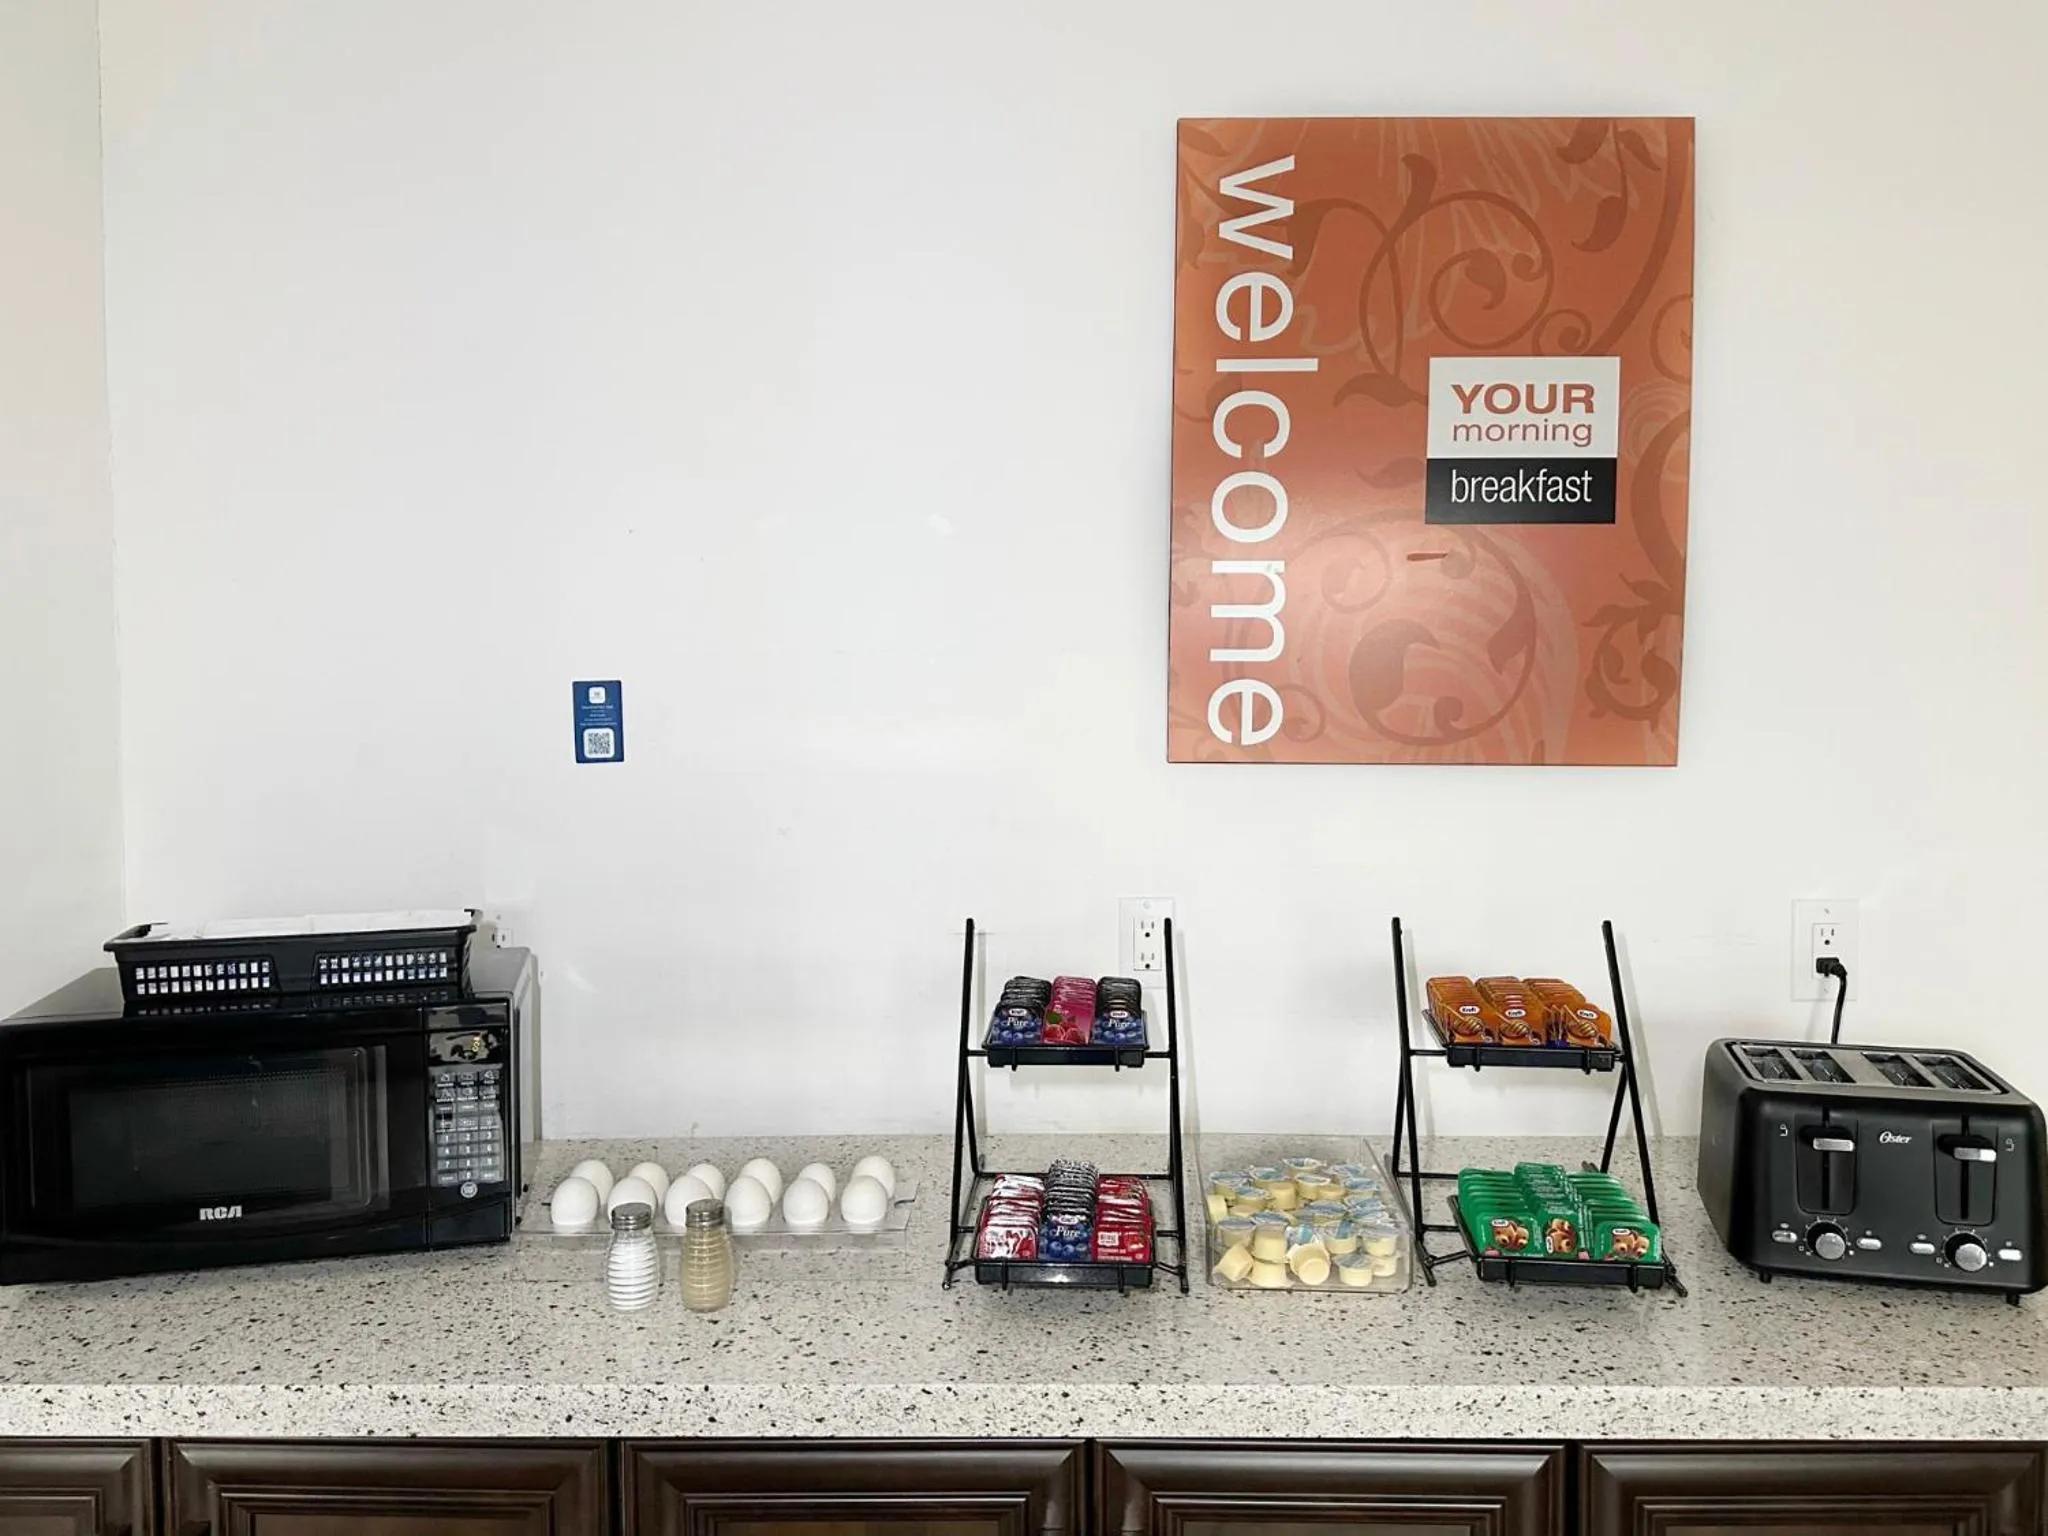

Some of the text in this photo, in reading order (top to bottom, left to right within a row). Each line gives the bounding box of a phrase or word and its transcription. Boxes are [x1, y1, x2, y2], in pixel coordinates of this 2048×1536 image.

[1450, 382, 1596, 415] YOUR
[1452, 418, 1593, 448] morning
[1206, 154, 1319, 746] welcome
[1450, 468, 1593, 504] breakfast
[1879, 1131, 1912, 1144] Oster
[199, 1205, 243, 1221] RCA
[1056, 1225, 1081, 1239] Pure
